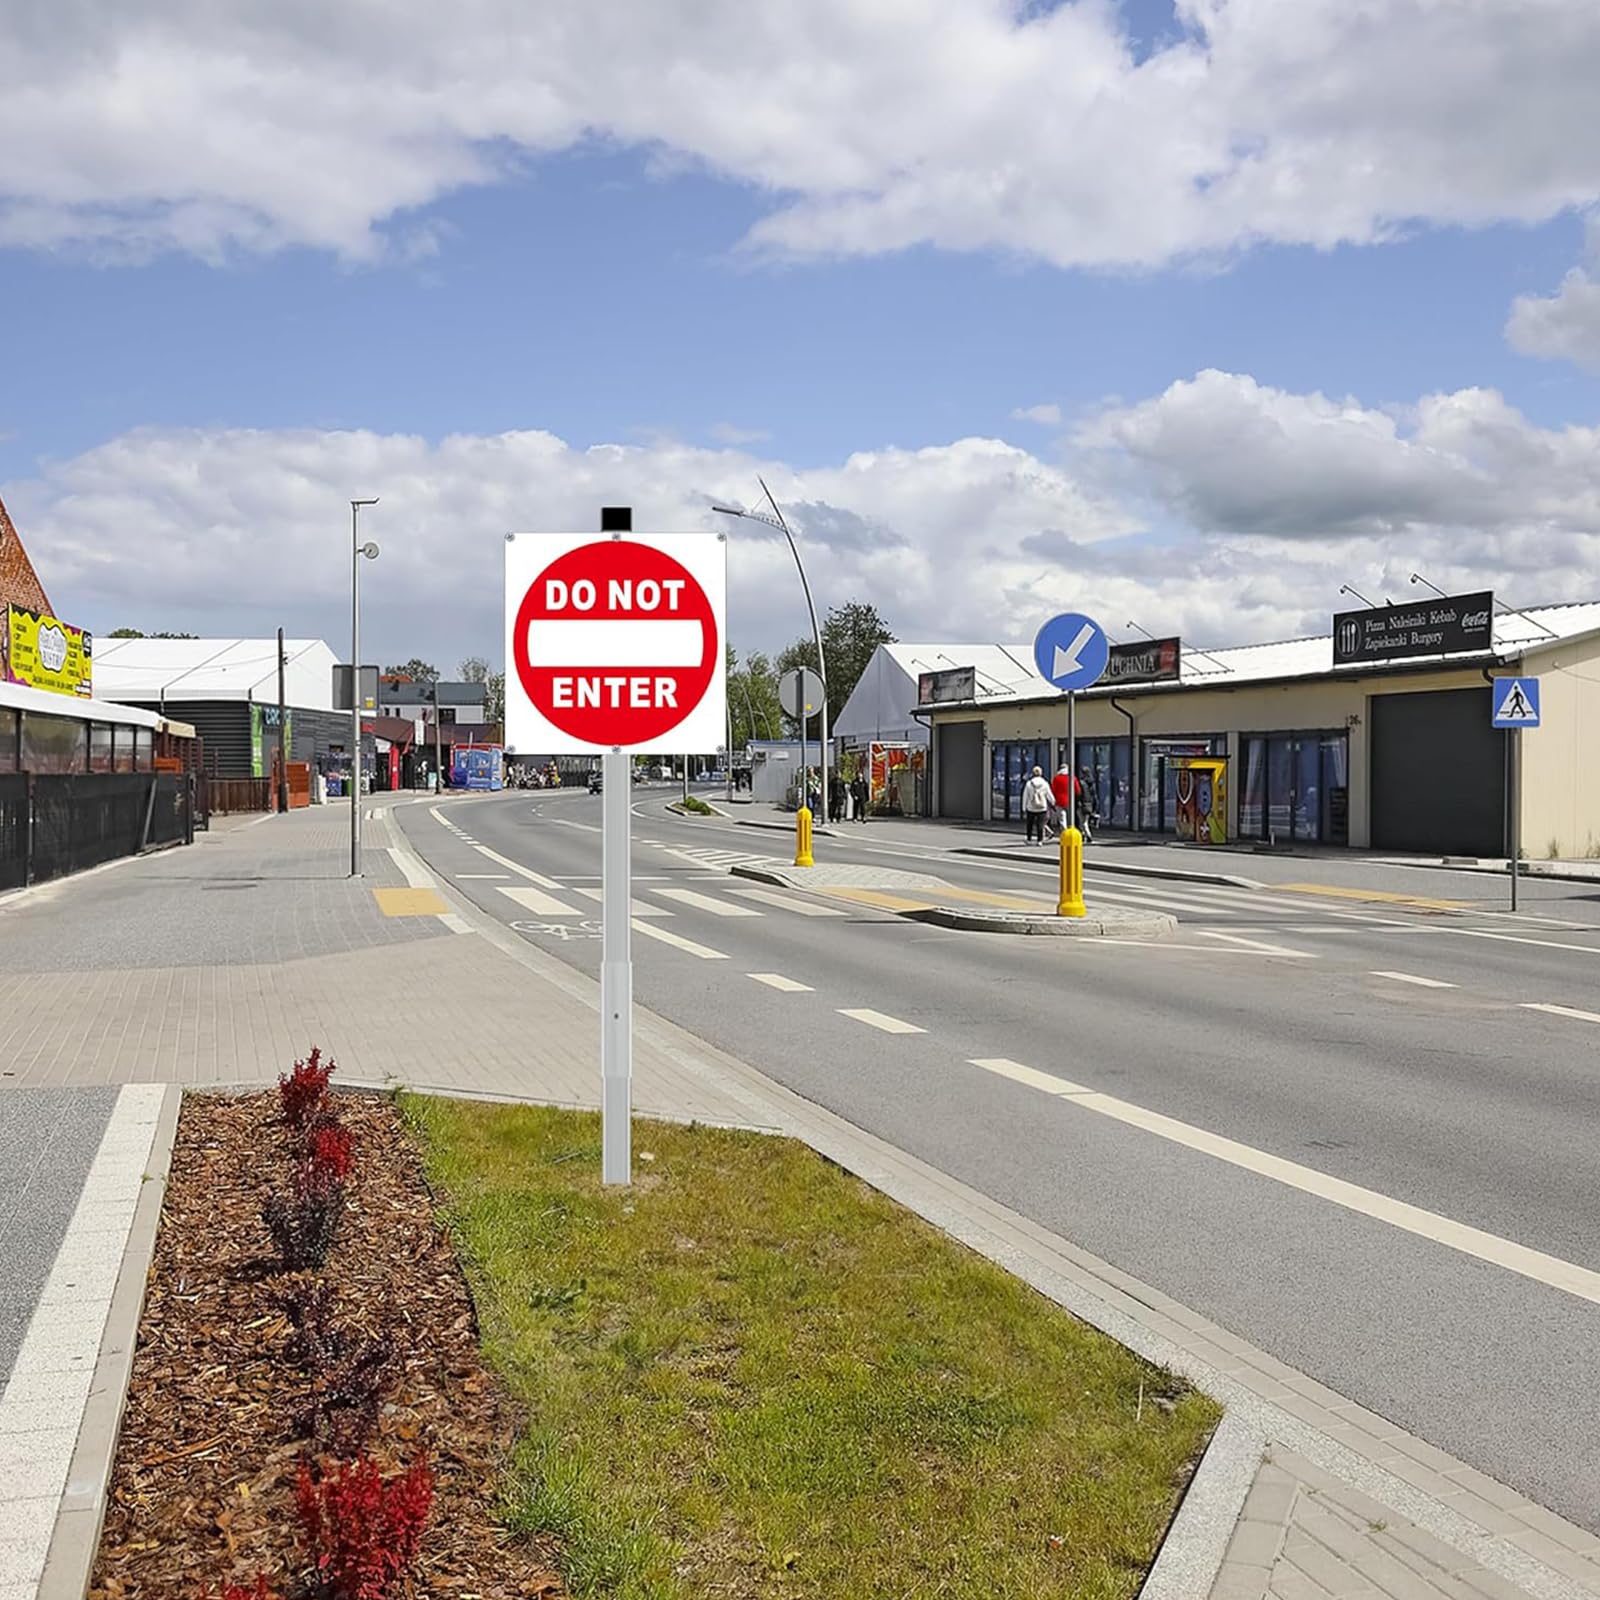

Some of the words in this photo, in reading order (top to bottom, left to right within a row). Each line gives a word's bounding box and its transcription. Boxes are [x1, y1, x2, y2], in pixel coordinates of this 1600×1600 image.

[545, 579, 597, 611] DO
[608, 579, 686, 611] NOT
[1365, 619, 1386, 633] Pizza
[1430, 608, 1458, 625] Kebab
[1109, 655, 1154, 676] UCHNIA
[552, 676, 678, 708] ENTER
